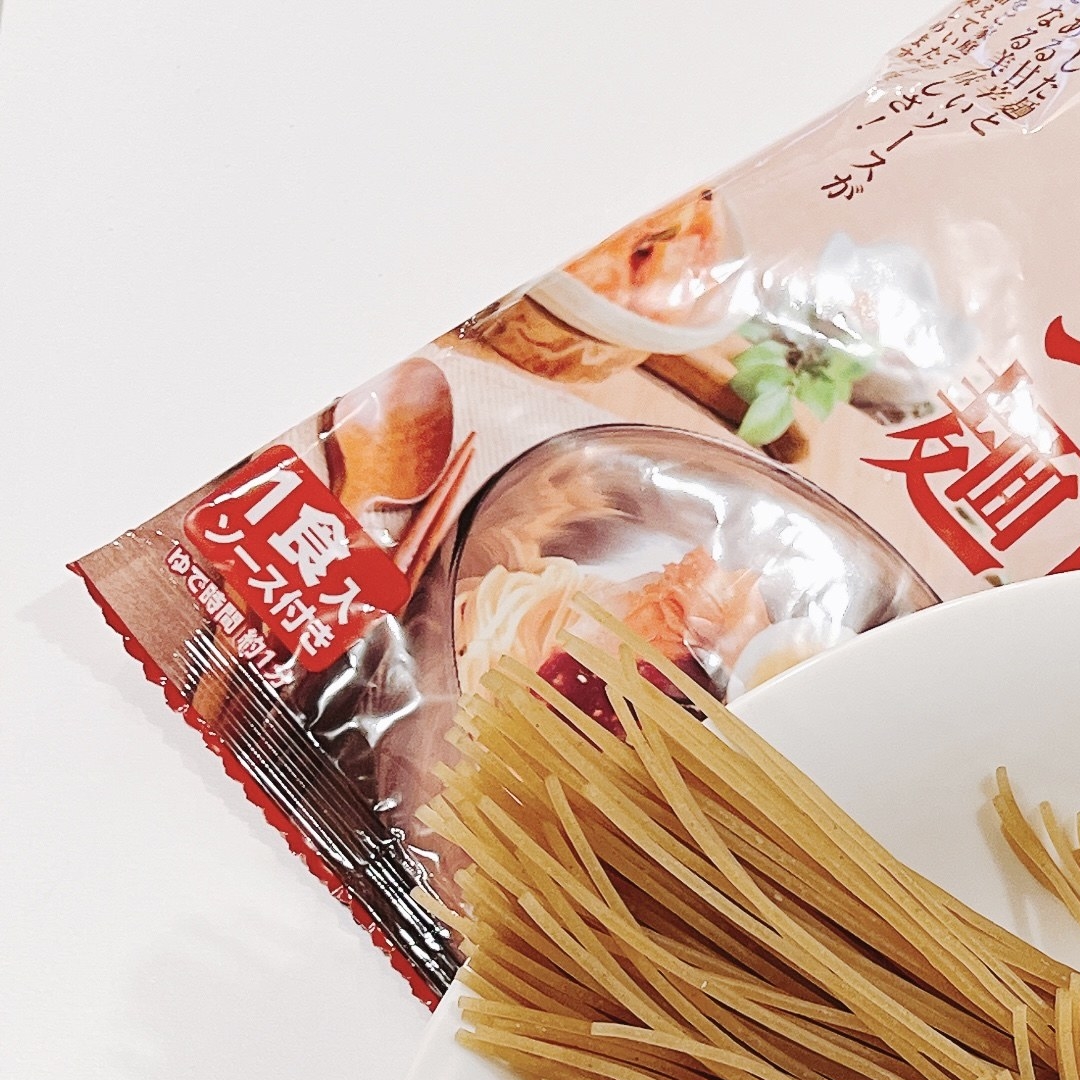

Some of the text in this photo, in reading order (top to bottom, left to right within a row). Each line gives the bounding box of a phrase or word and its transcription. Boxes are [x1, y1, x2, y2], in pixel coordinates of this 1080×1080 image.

[203, 514, 336, 656] ソース付き
[244, 467, 361, 624] 1食入
